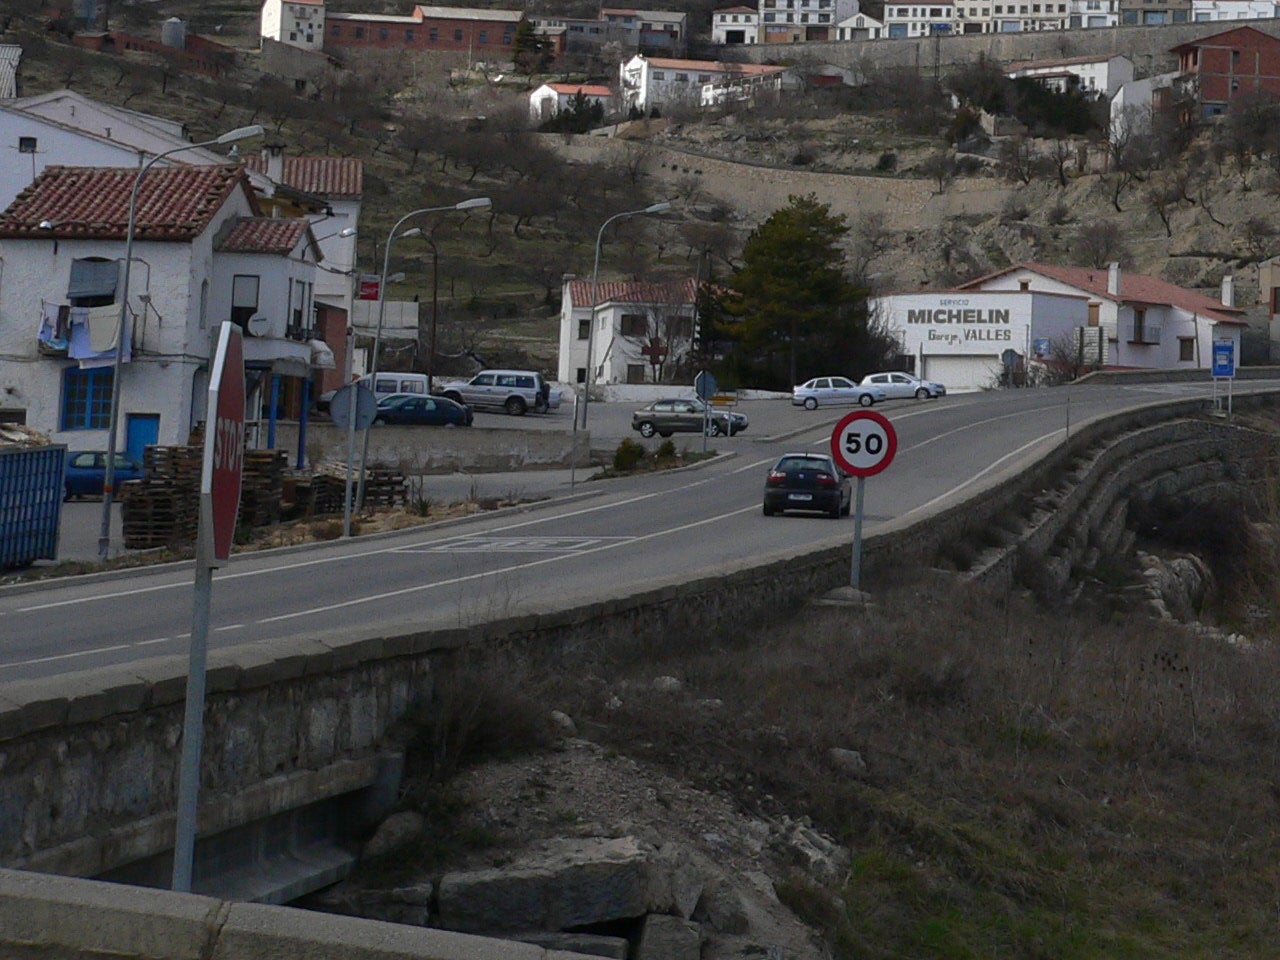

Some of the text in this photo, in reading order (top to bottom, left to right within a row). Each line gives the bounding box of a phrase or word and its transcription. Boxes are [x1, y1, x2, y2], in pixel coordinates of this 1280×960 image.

[907, 309, 1010, 324] MICHELIN
[963, 328, 1011, 341] VALLES
[215, 416, 244, 472] STOP
[846, 432, 883, 455] 50
